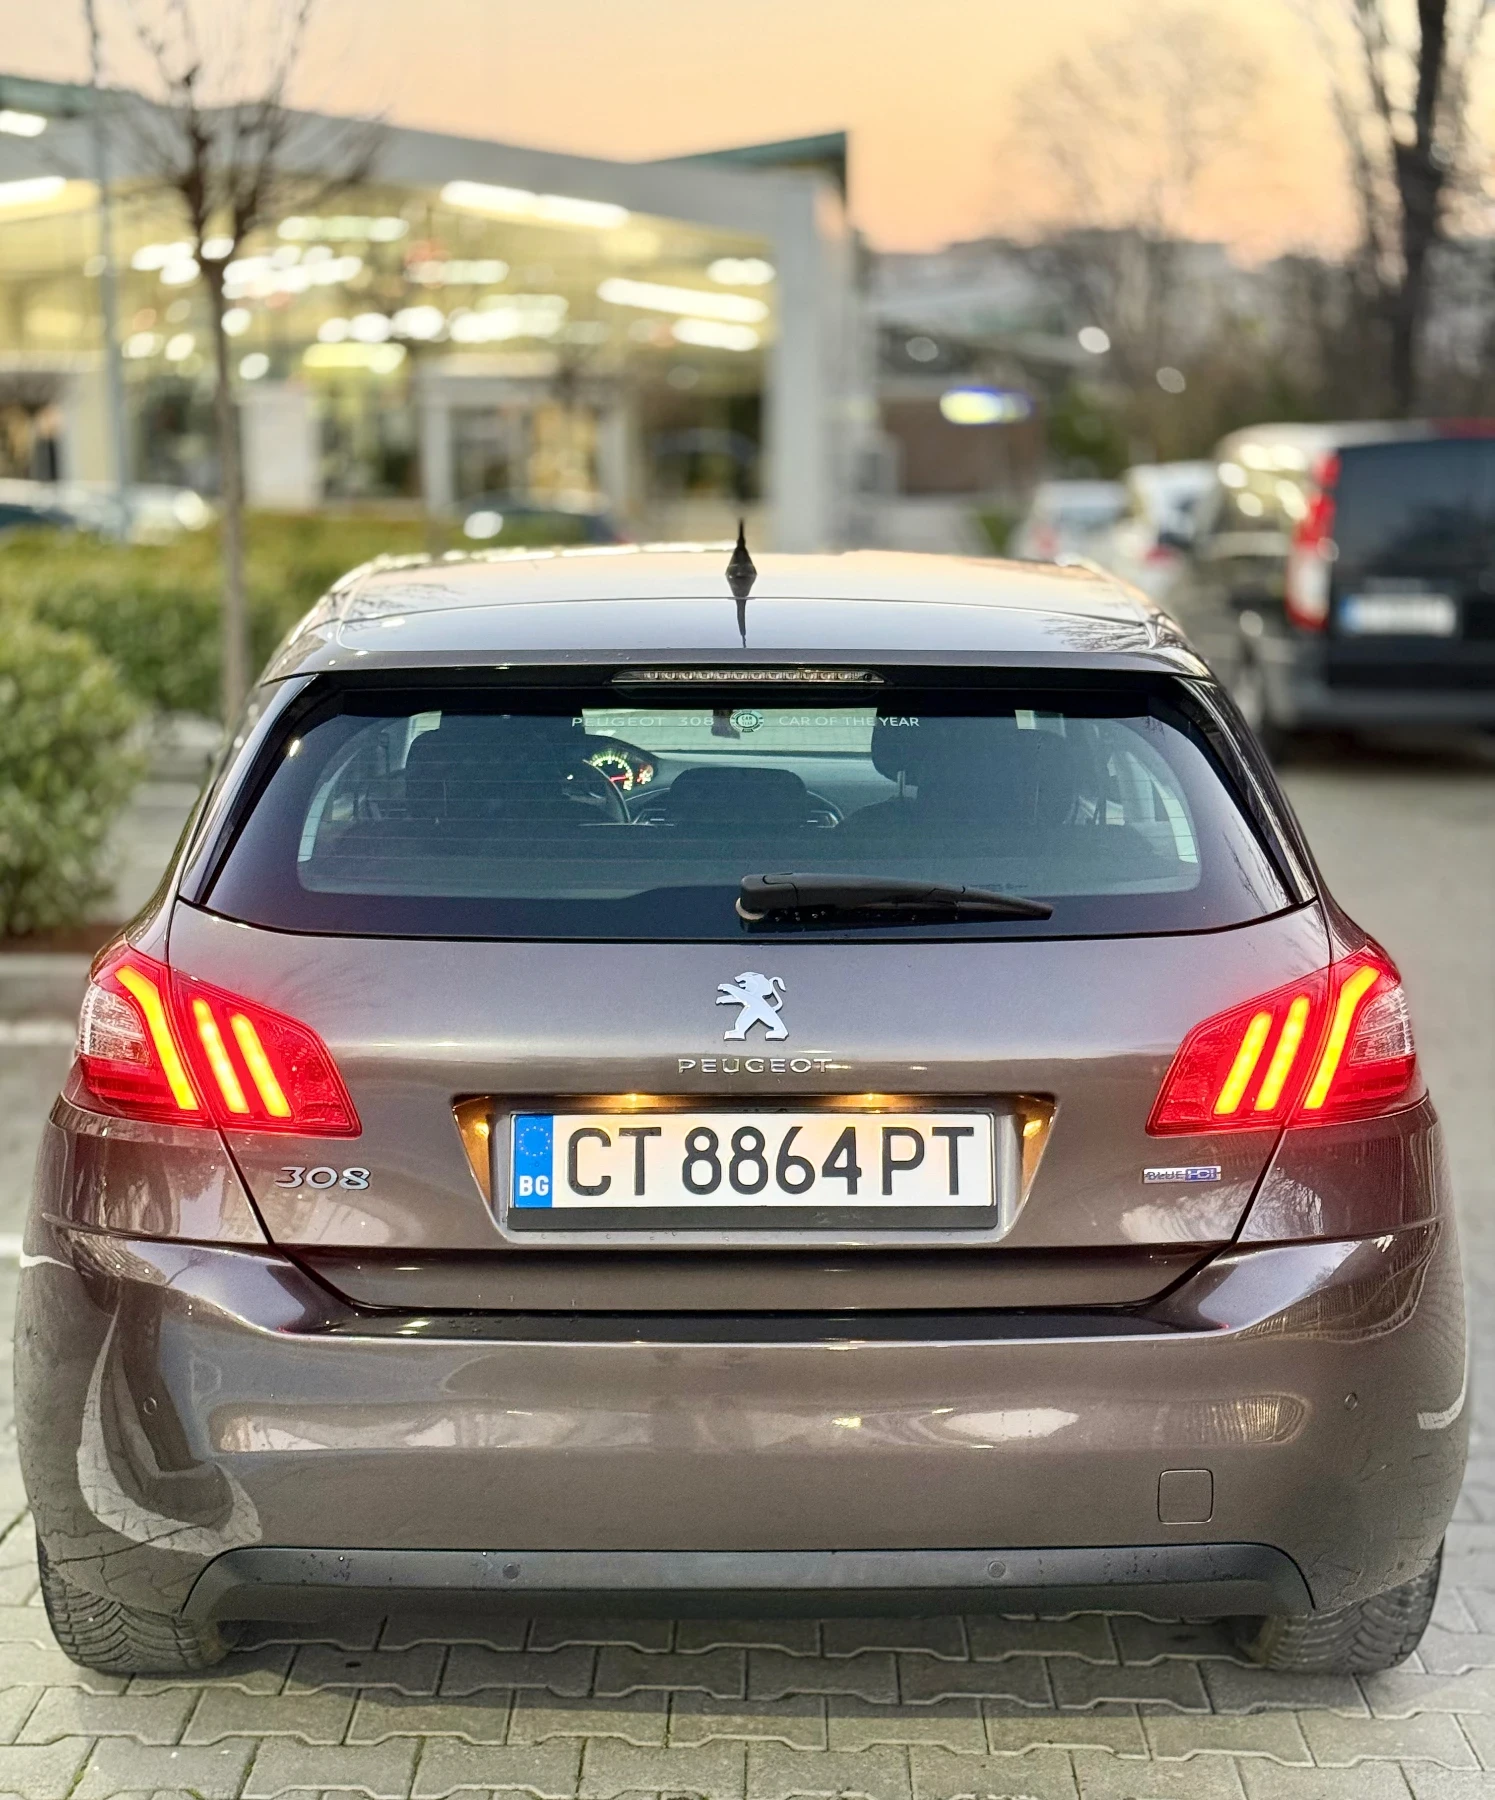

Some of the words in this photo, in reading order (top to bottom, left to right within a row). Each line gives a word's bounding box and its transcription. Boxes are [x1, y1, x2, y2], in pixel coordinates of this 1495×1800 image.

[571, 716, 667, 727] PEUGEOT
[678, 716, 714, 727] 308
[779, 716, 811, 727] CAR
[815, 716, 838, 727] OF
[843, 716, 876, 727] THE
[878, 716, 920, 727] YEAR
[677, 1058, 833, 1074] PEUGEOT
[567, 1127, 662, 1197] CT
[682, 1126, 862, 1196] 8864
[881, 1126, 975, 1196] PT
[274, 1166, 371, 1191] 308
[518, 1175, 550, 1197] BG
